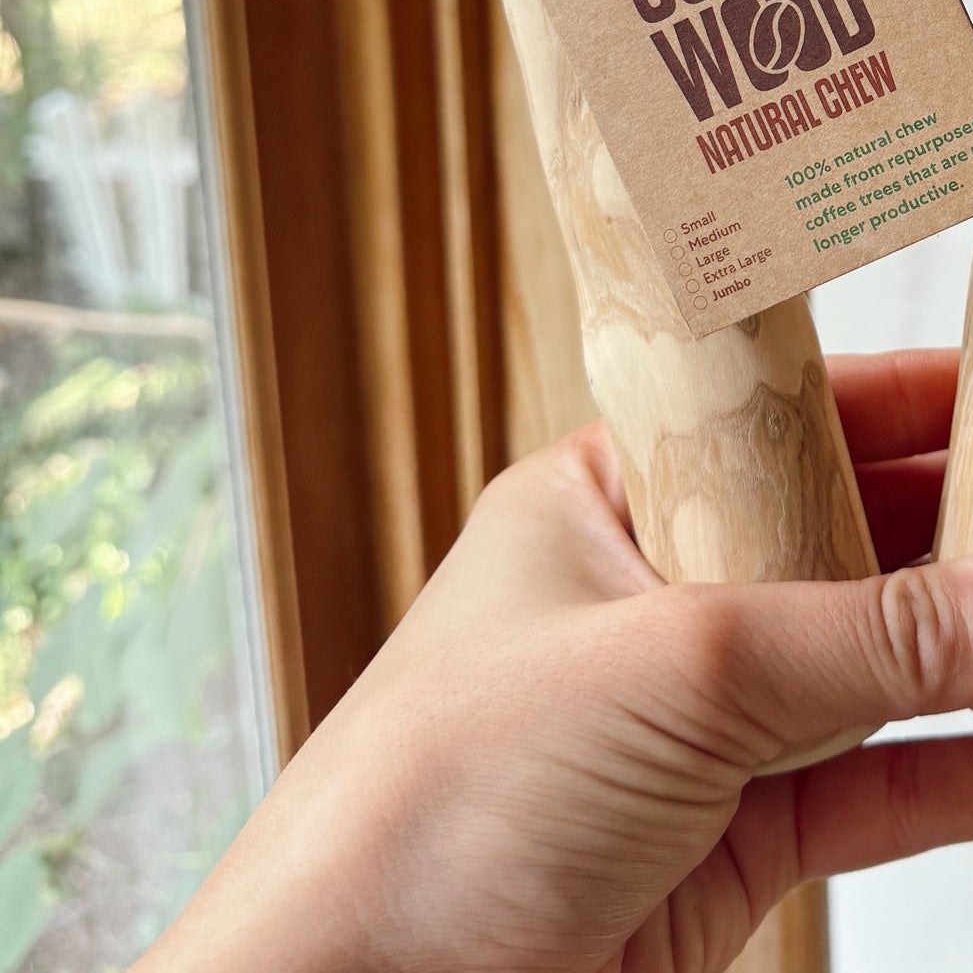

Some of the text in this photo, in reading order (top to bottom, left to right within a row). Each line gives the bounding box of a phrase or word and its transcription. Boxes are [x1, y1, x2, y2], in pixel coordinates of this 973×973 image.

[696, 51, 896, 174] NATURAL CHEW
[784, 112, 937, 189] 100% natural chew
[795, 182, 842, 211] made
[843, 163, 885, 188] from
[805, 201, 857, 231] coffee
[859, 180, 901, 207] trees
[903, 163, 939, 187] that
[941, 152, 968, 171] are
[680, 210, 717, 235] Small
[688, 221, 742, 251] Medium
[813, 180, 965, 253] longer productive.
[696, 246, 730, 268] Large
[703, 247, 773, 284] Extra Large
[712, 276, 751, 302] Jumbo
